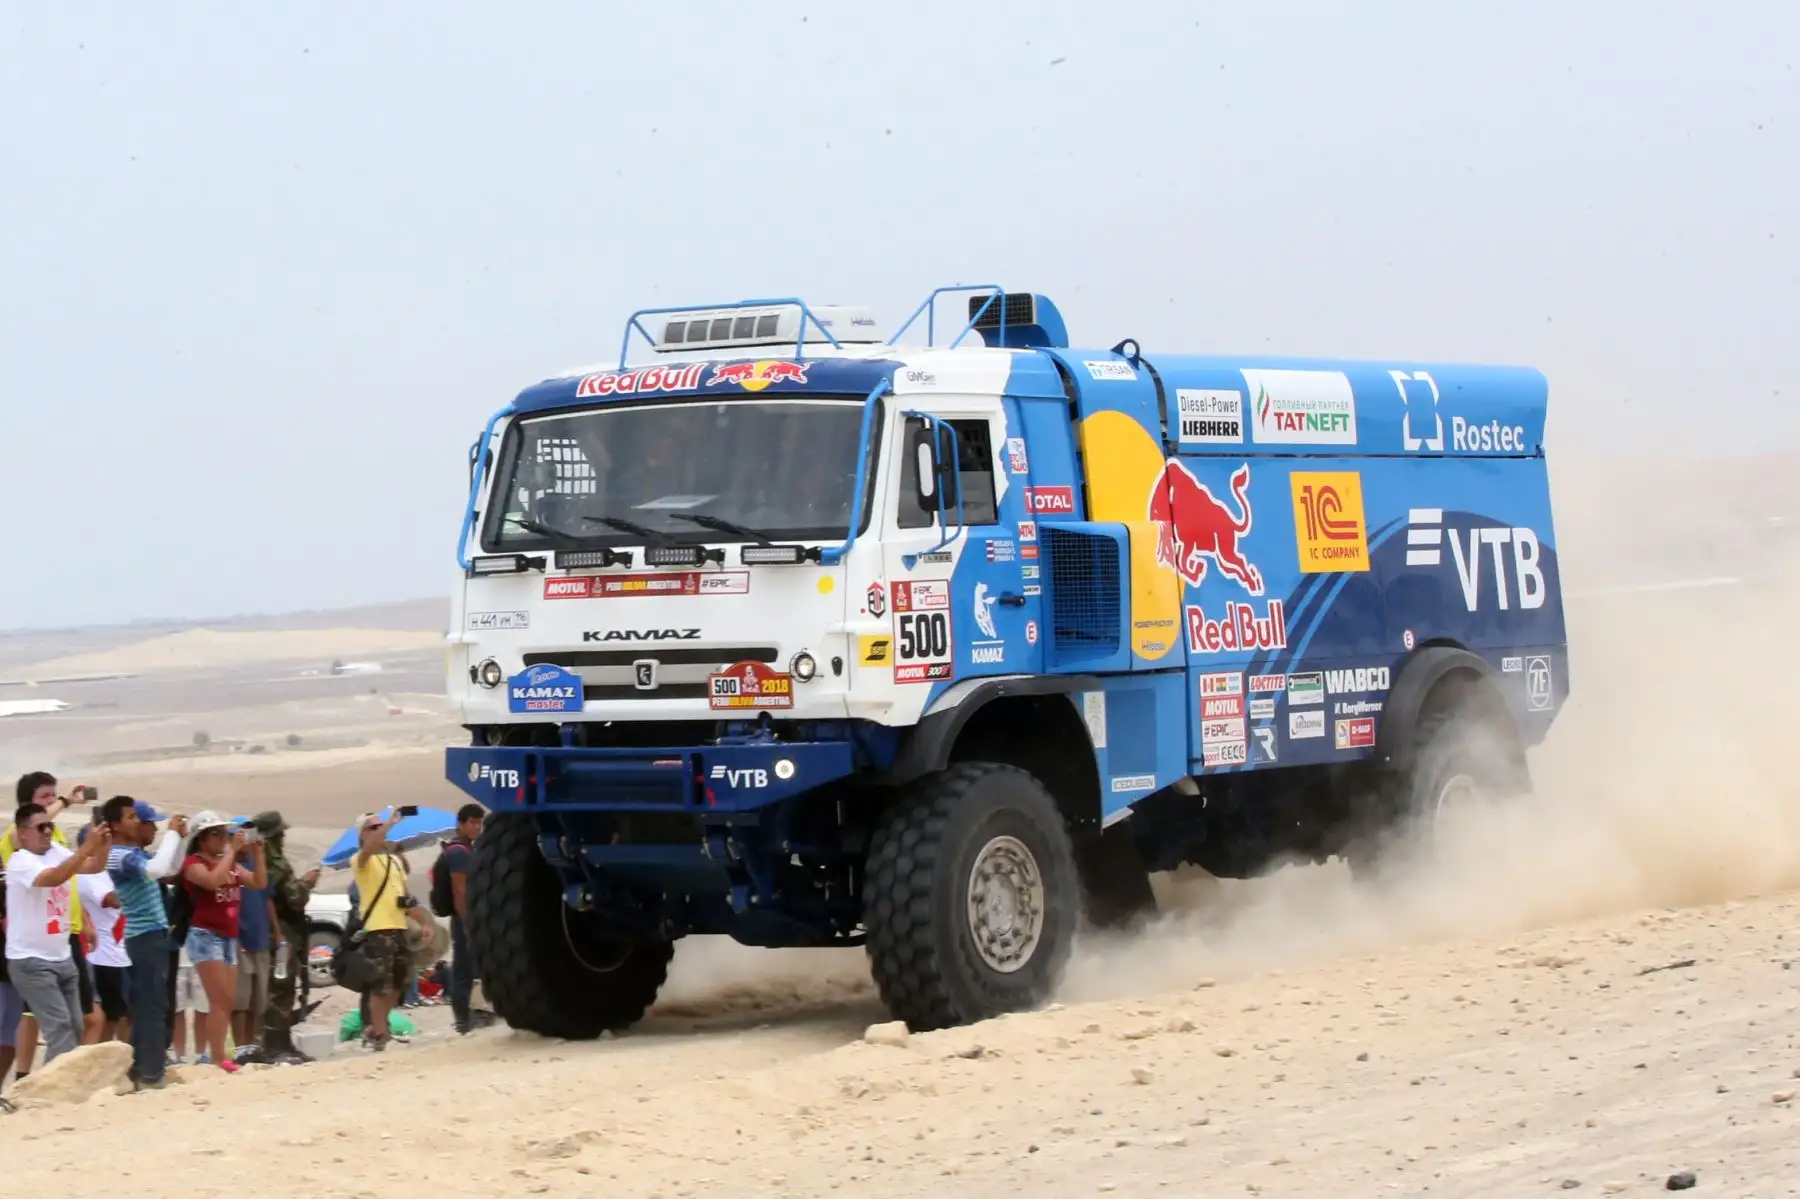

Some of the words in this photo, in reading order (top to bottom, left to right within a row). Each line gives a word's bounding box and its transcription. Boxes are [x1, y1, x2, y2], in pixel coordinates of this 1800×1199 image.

[576, 371, 640, 397] Red
[638, 362, 710, 392] Bull
[1180, 396, 1238, 412] Diesel-Power
[1183, 420, 1240, 436] LIEBHERR
[1274, 412, 1350, 432] TATNEFT
[1452, 416, 1525, 451] Rostec
[1025, 492, 1072, 509] TOTAL
[1322, 547, 1360, 560] COMPANY
[1448, 527, 1545, 611] VTB
[547, 582, 585, 594] MOTUL
[1186, 601, 1240, 654] Red
[1236, 599, 1287, 650] Bull
[583, 628, 701, 642] KAMAZ
[900, 613, 947, 659] 500
[972, 648, 1004, 663] KAMAZ
[896, 666, 925, 679] MOTUL
[1325, 667, 1390, 694] WABCO
[714, 679, 737, 694] 500
[762, 679, 788, 693] 2018
[1251, 676, 1285, 690] LOCTITE
[513, 687, 576, 699] KAMAZ
[527, 700, 564, 710] master
[1205, 699, 1239, 716] MOTUL
[1204, 723, 1229, 737] #EPIC
[490, 769, 519, 788] VTB
[727, 768, 768, 788] VTB
